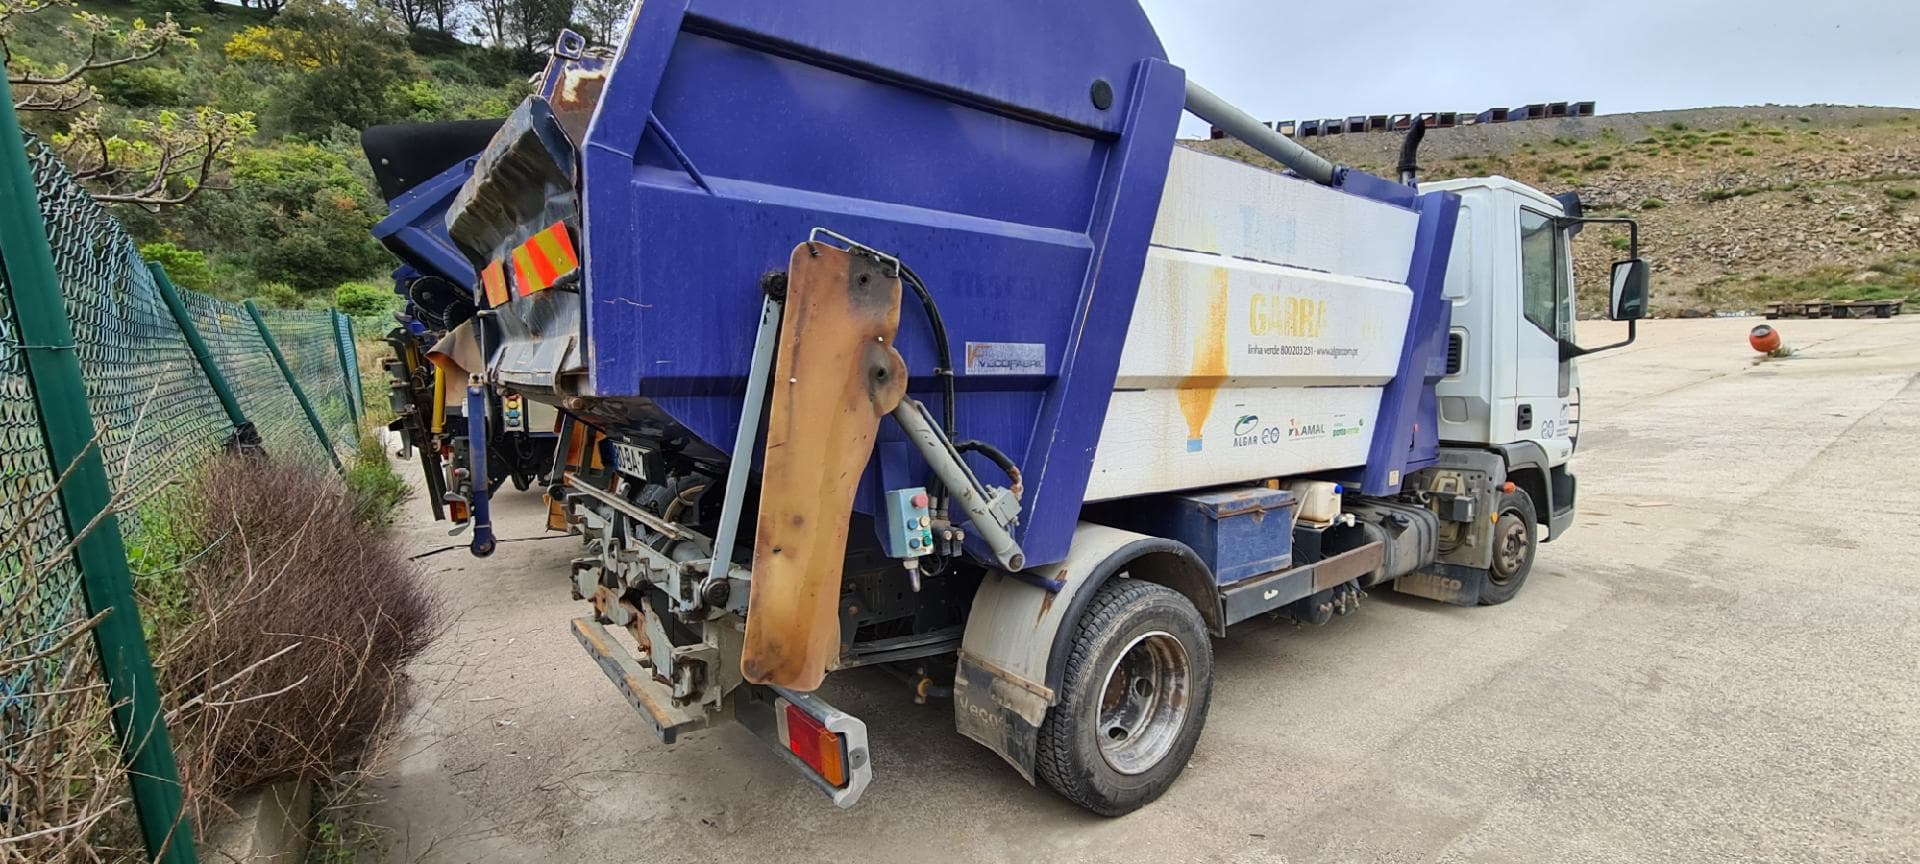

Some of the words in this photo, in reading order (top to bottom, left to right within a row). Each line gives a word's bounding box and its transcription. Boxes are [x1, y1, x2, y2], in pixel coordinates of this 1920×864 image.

[1264, 345, 1279, 355] verde
[1302, 423, 1325, 436] AMAL
[1233, 436, 1258, 447] ALGAR
